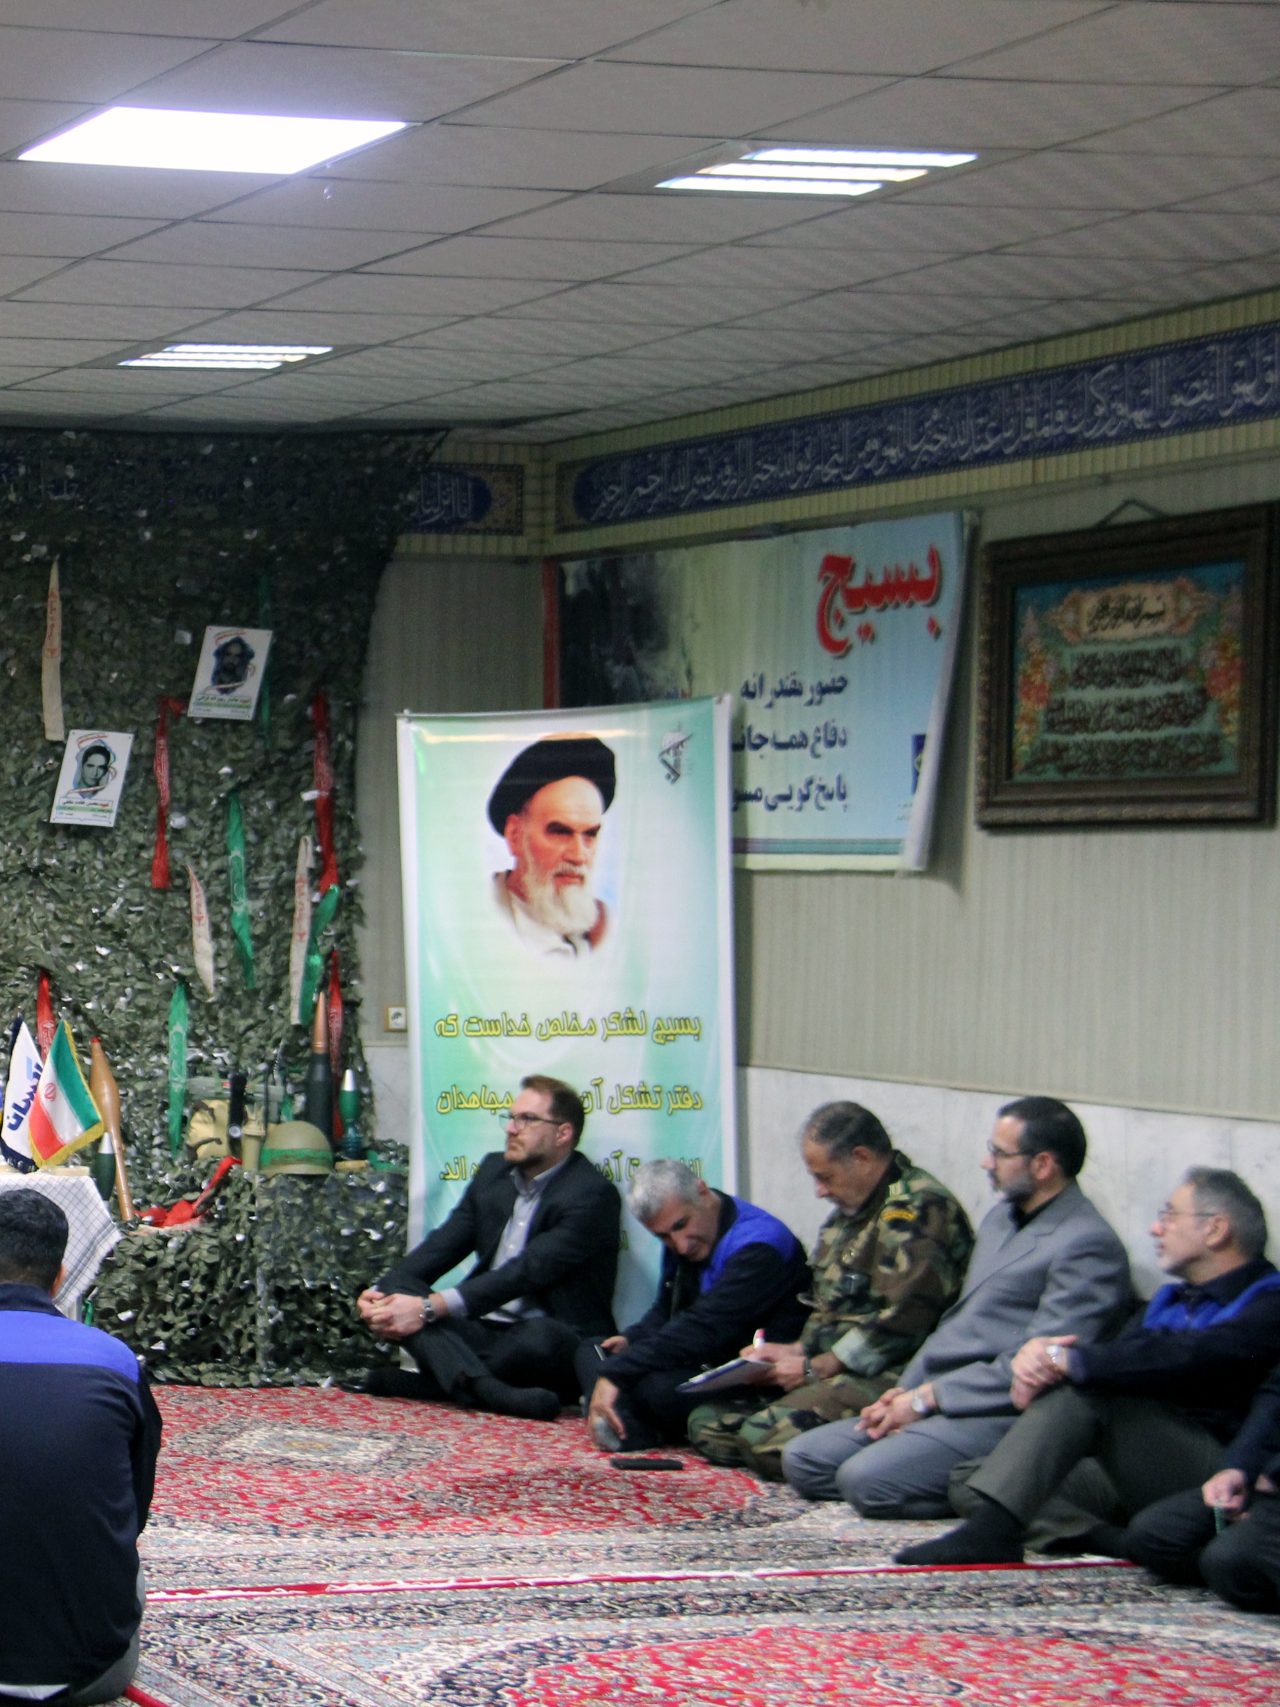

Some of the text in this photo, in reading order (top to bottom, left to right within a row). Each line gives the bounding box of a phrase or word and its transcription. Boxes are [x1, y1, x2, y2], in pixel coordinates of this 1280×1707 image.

[817, 542, 943, 657] بسیج
[803, 674, 849, 707] حضور
[810, 718, 848, 759] دفاع
[434, 1007, 702, 1045] بسیج لشکر مخلص خداست که
[435, 1084, 514, 1115] مجاهدان
[607, 1080, 662, 1114] تشکل
[667, 1086, 704, 1115] دفتر
